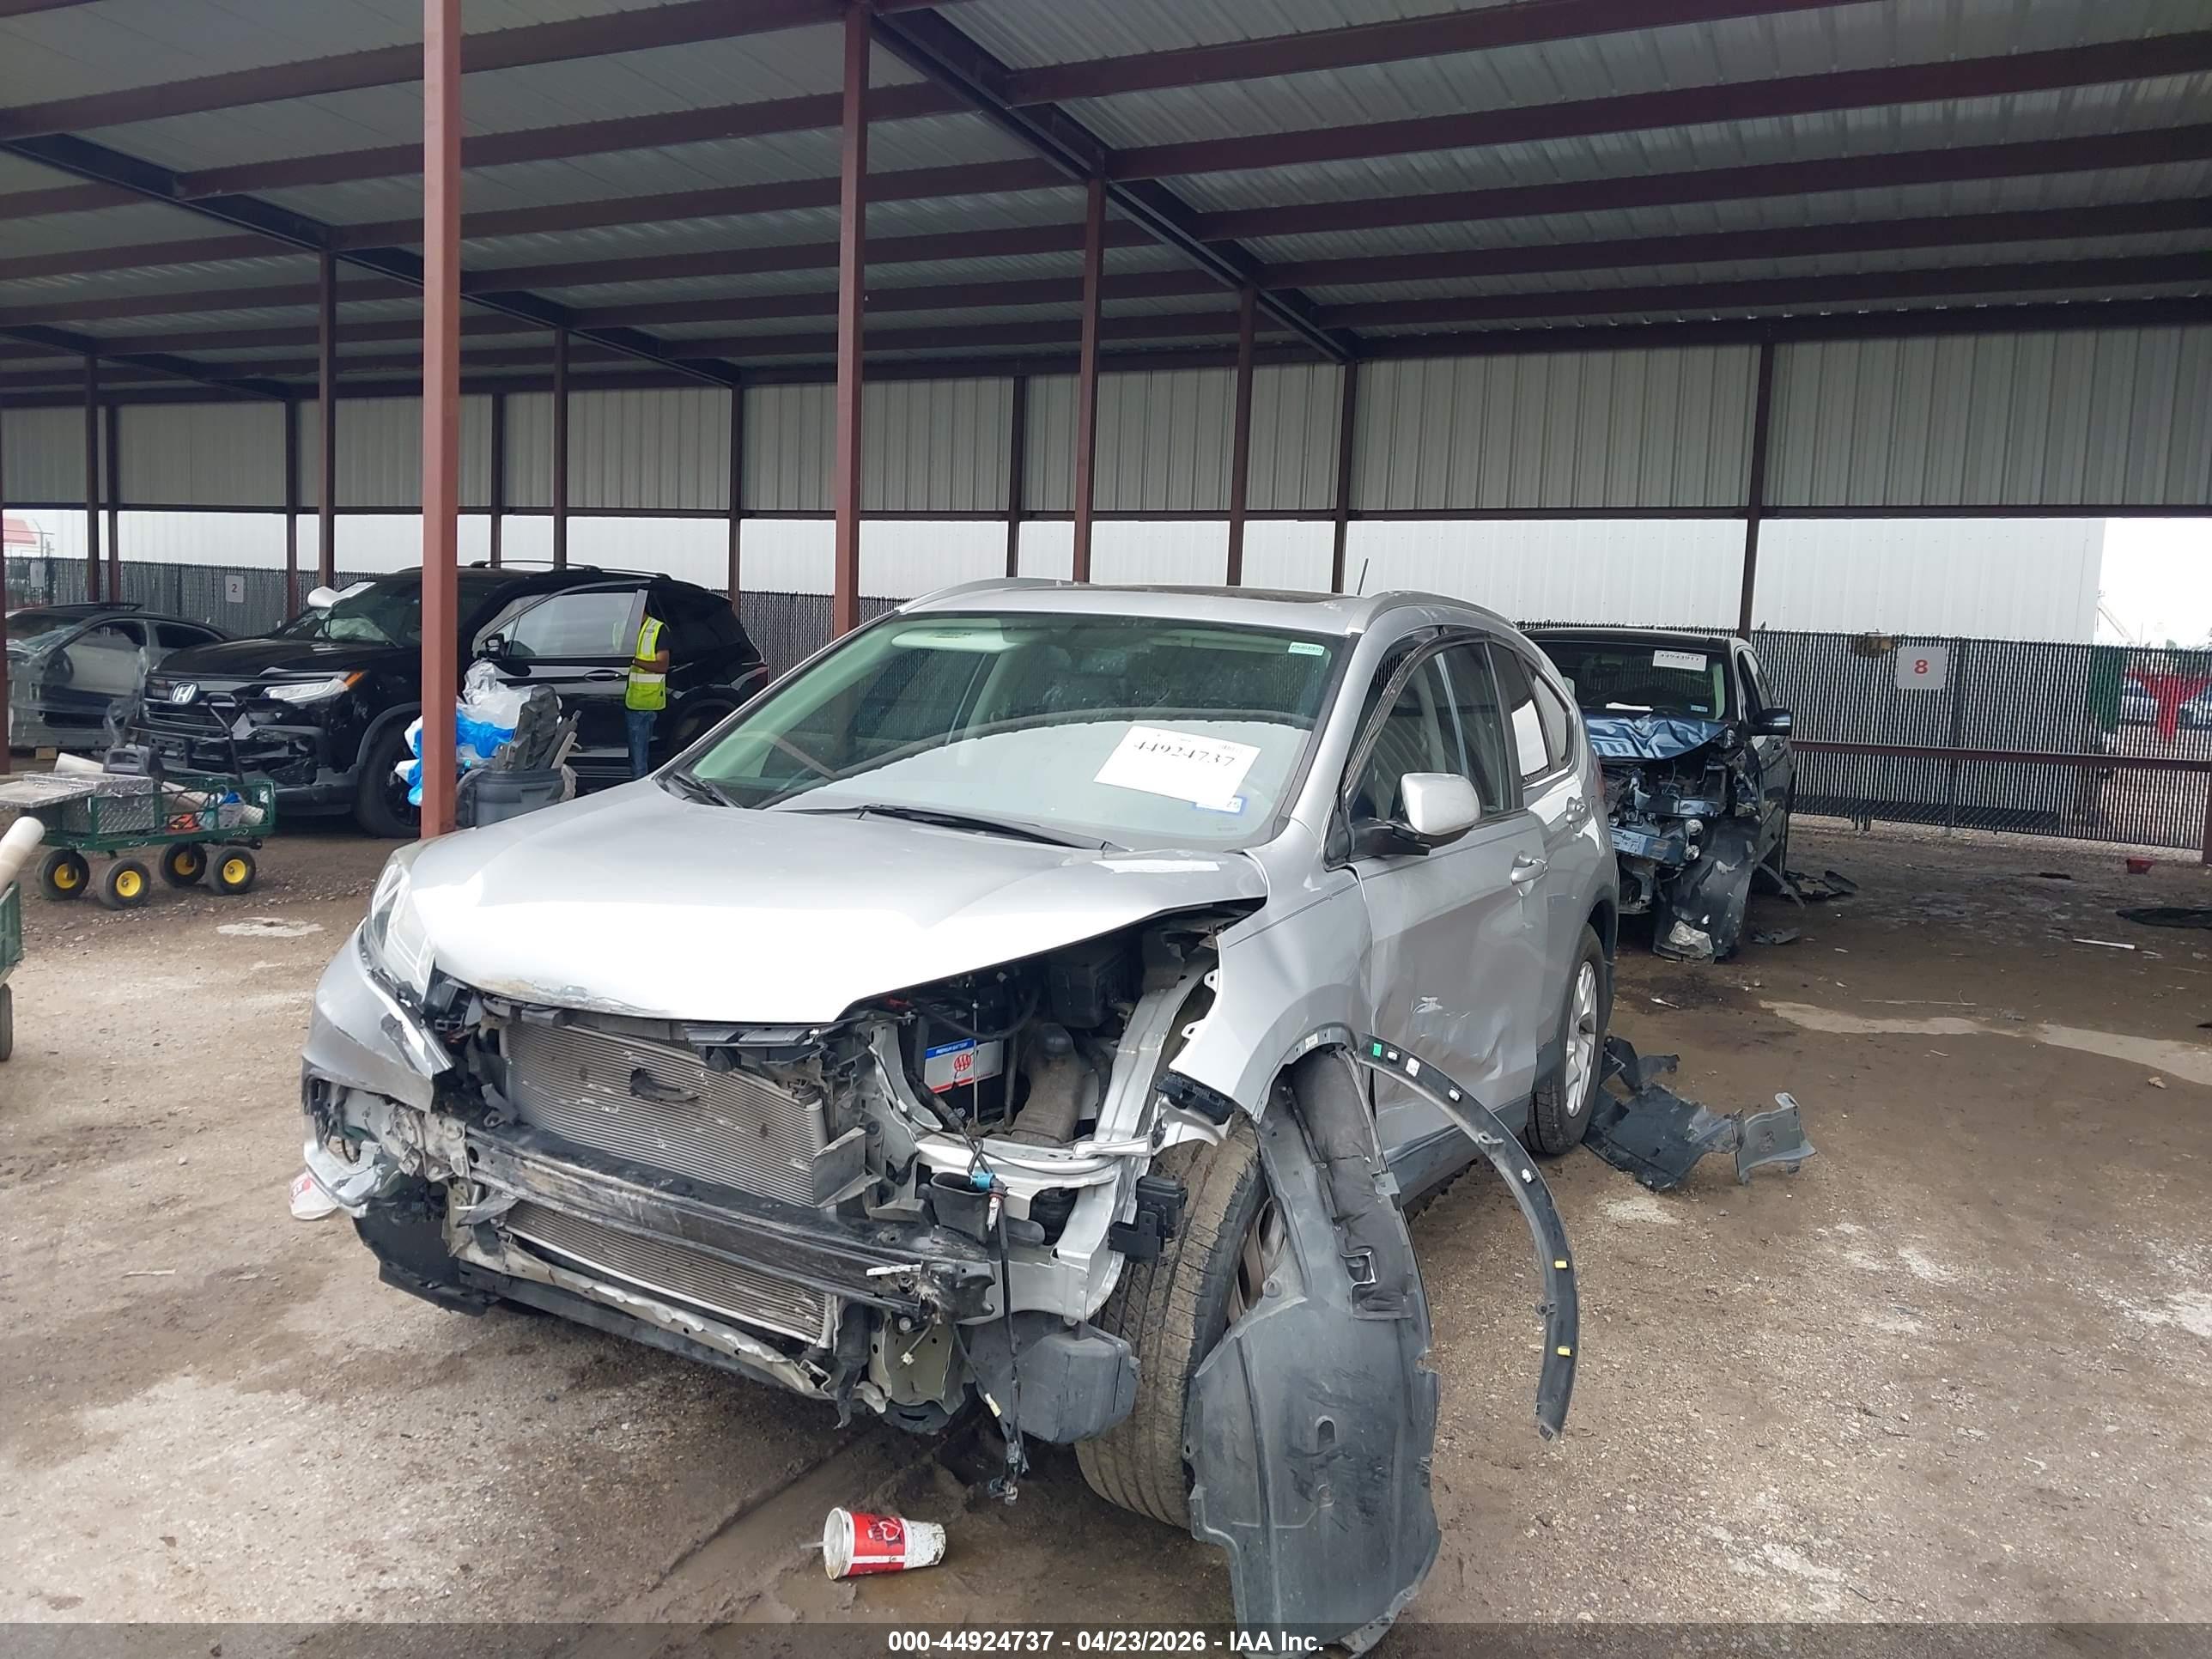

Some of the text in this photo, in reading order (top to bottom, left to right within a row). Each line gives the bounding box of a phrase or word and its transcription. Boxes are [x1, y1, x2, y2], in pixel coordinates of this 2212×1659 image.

[231, 583, 238, 593] 2
[1913, 659, 1929, 674] 8
[1133, 741, 1236, 767] 44924737
